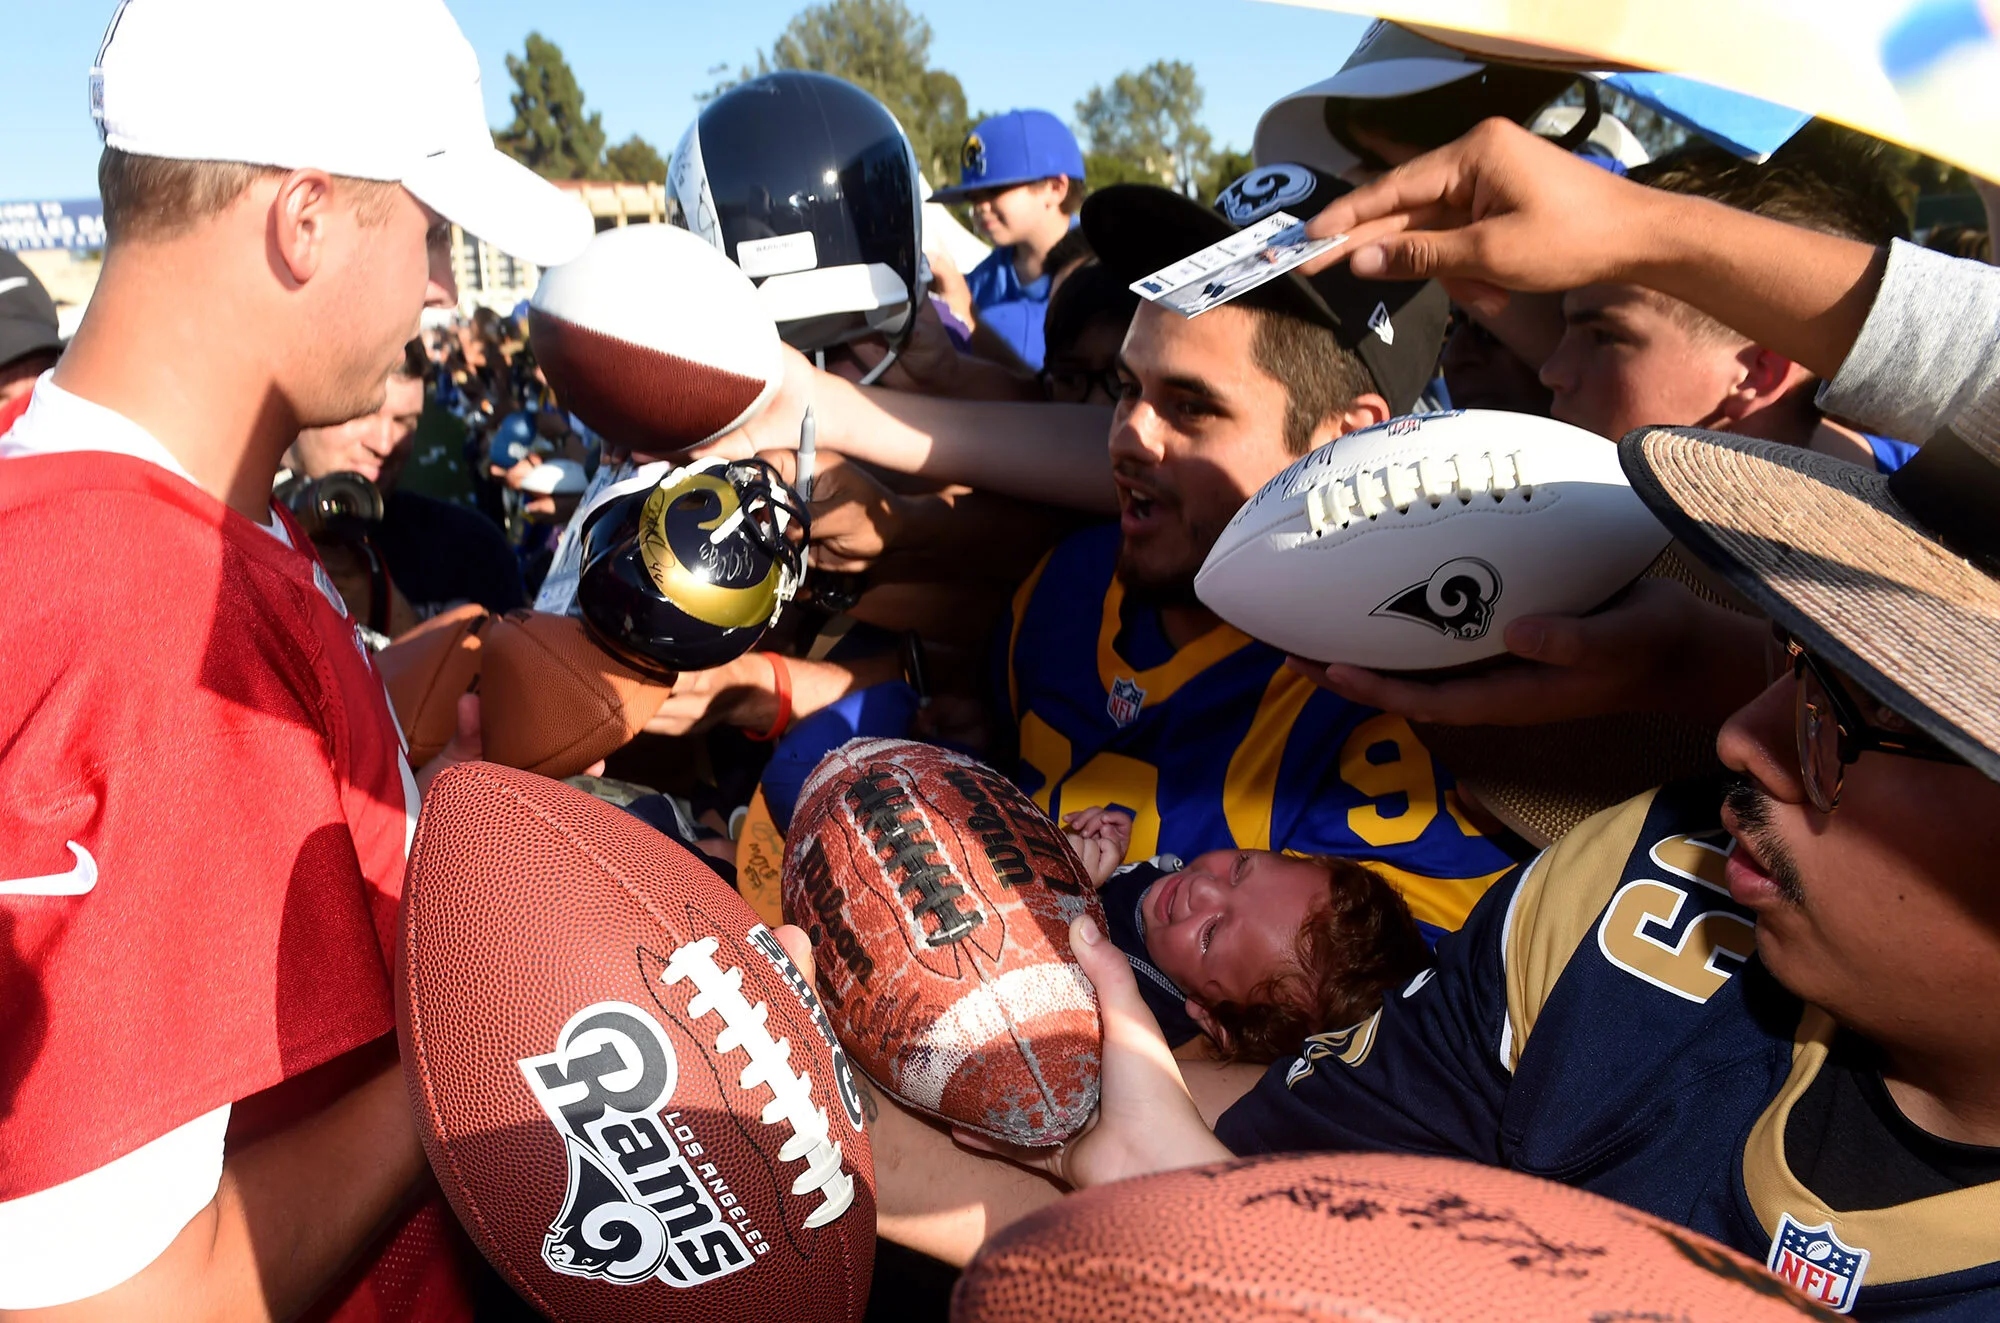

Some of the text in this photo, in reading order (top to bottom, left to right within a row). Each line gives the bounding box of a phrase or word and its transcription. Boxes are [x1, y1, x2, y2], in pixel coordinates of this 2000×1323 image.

[1111, 696, 1133, 721] NFL
[943, 769, 1035, 892] Wilson
[1339, 712, 1483, 847] 9
[800, 837, 874, 995] Wilson
[524, 1005, 750, 1284] Rams
[664, 1111, 770, 1255] LOS ANGELES
[1778, 1250, 1840, 1304] NFL
